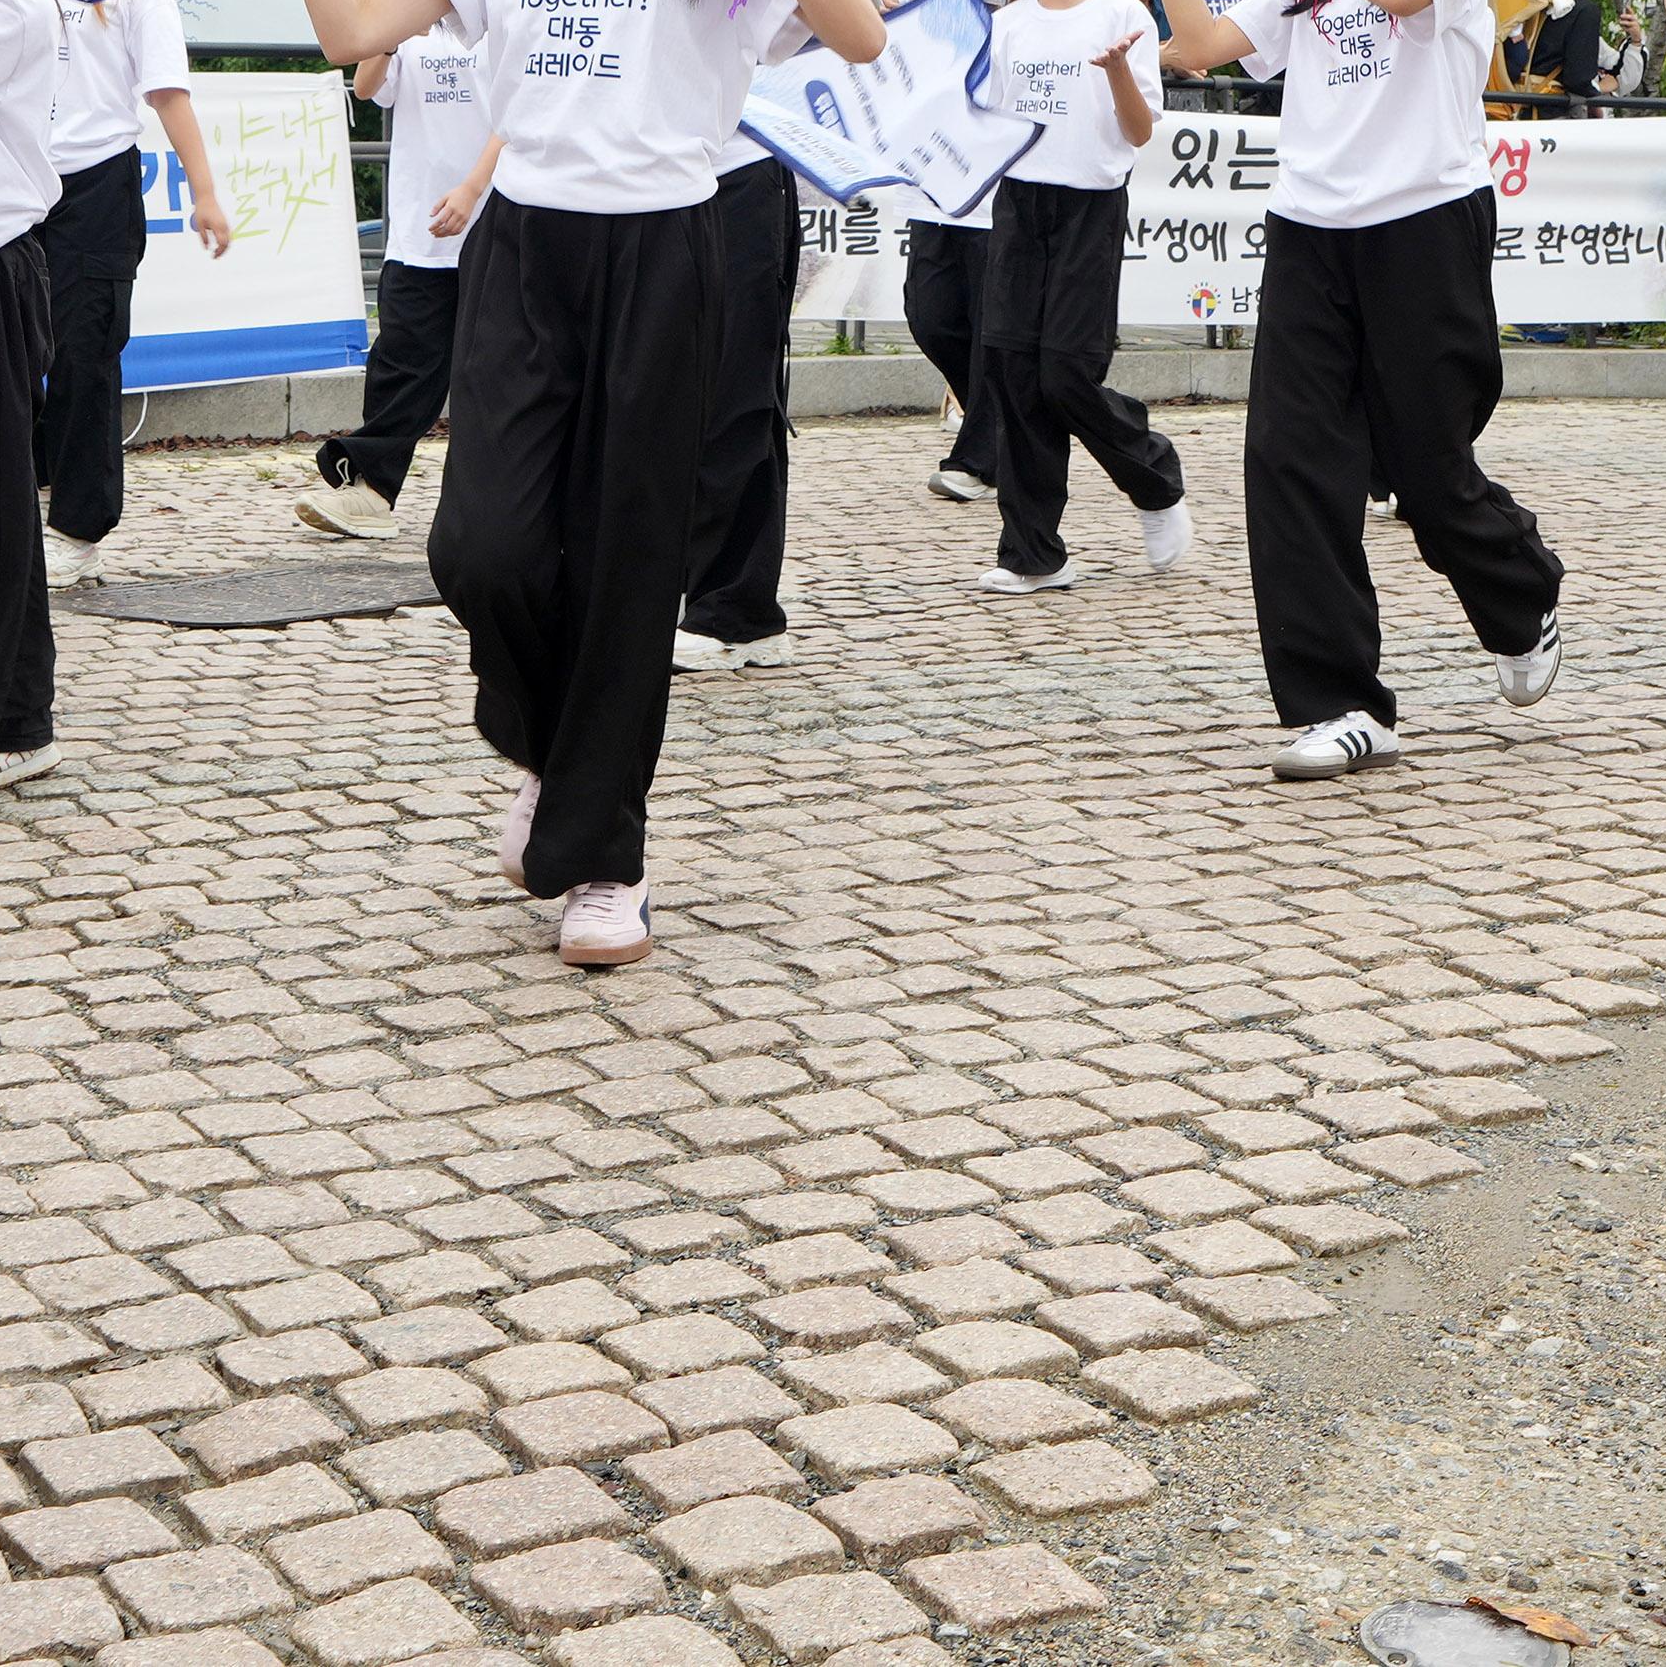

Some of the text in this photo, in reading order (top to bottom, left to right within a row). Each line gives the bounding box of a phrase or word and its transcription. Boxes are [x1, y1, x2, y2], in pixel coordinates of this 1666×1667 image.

[1315, 5, 1387, 37] Togethe
[548, 16, 601, 49] 대동
[1340, 33, 1375, 59] 대동
[419, 54, 478, 73] Together!
[525, 52, 621, 79] 퍼레이드
[1012, 60, 1082, 79] Together!
[1327, 57, 1392, 87] 퍼레이드
[436, 72, 458, 89] 대동
[1029, 79, 1055, 98] 대동
[425, 90, 473, 104] 퍼레이드
[1015, 99, 1068, 115] 퍼레이드
[1171, 128, 1557, 197] 있는 성”
